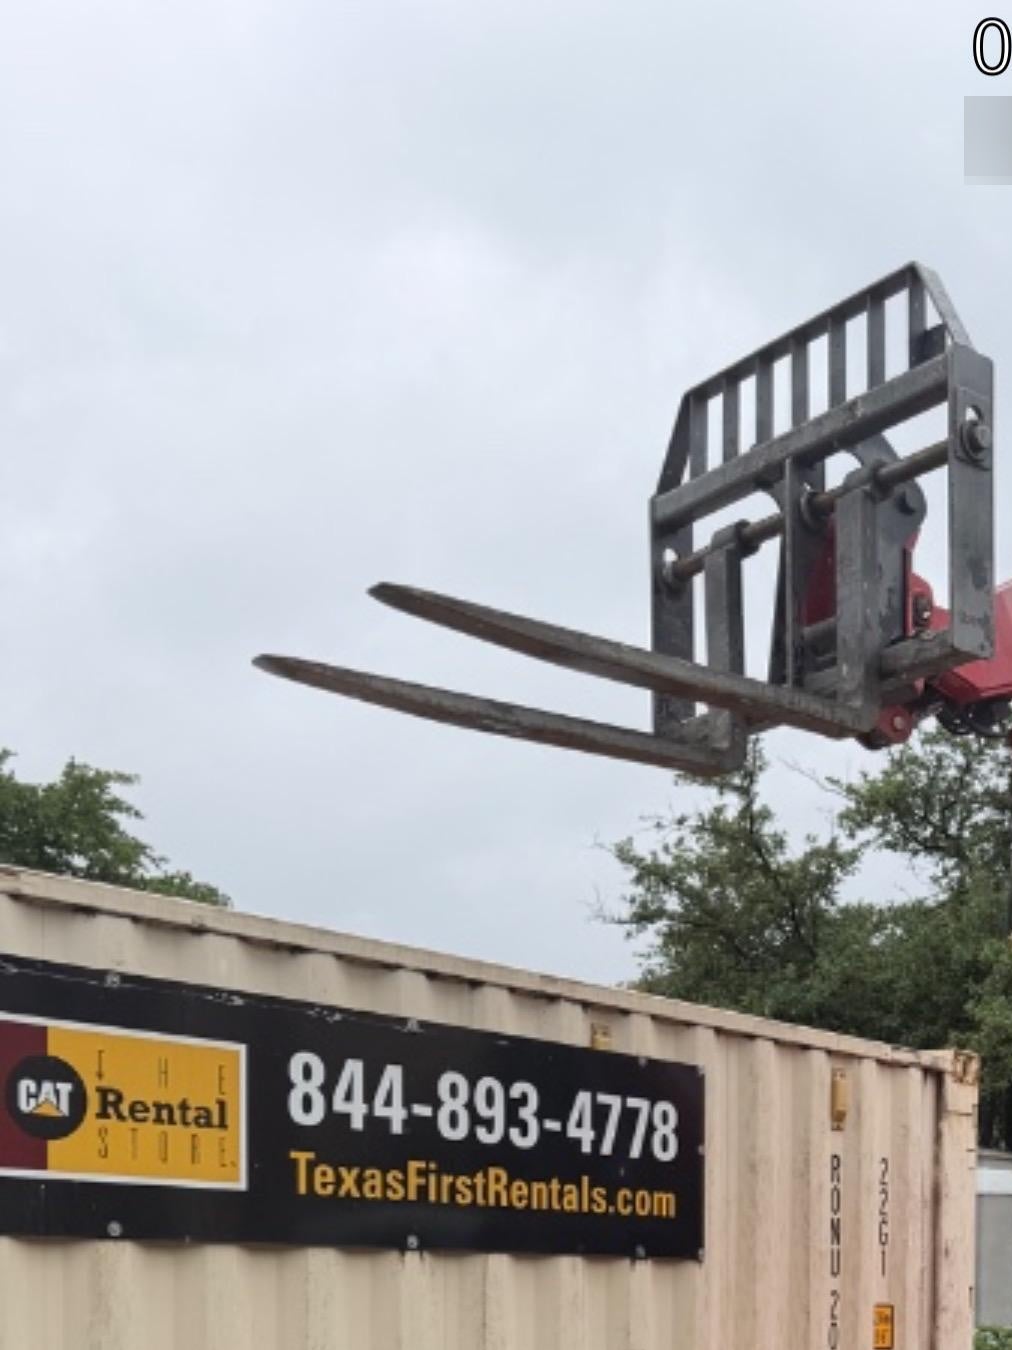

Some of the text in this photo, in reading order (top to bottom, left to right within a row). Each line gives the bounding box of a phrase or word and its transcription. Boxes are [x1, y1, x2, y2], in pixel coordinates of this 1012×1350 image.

[96, 1049, 226, 1096] THE
[16, 1077, 73, 1118] CAT
[95, 1085, 228, 1130] Rental
[287, 1051, 680, 1162] 844-893-4778
[97, 1127, 230, 1169] STORE
[288, 1150, 678, 1220] TexasFirstRentals.com
